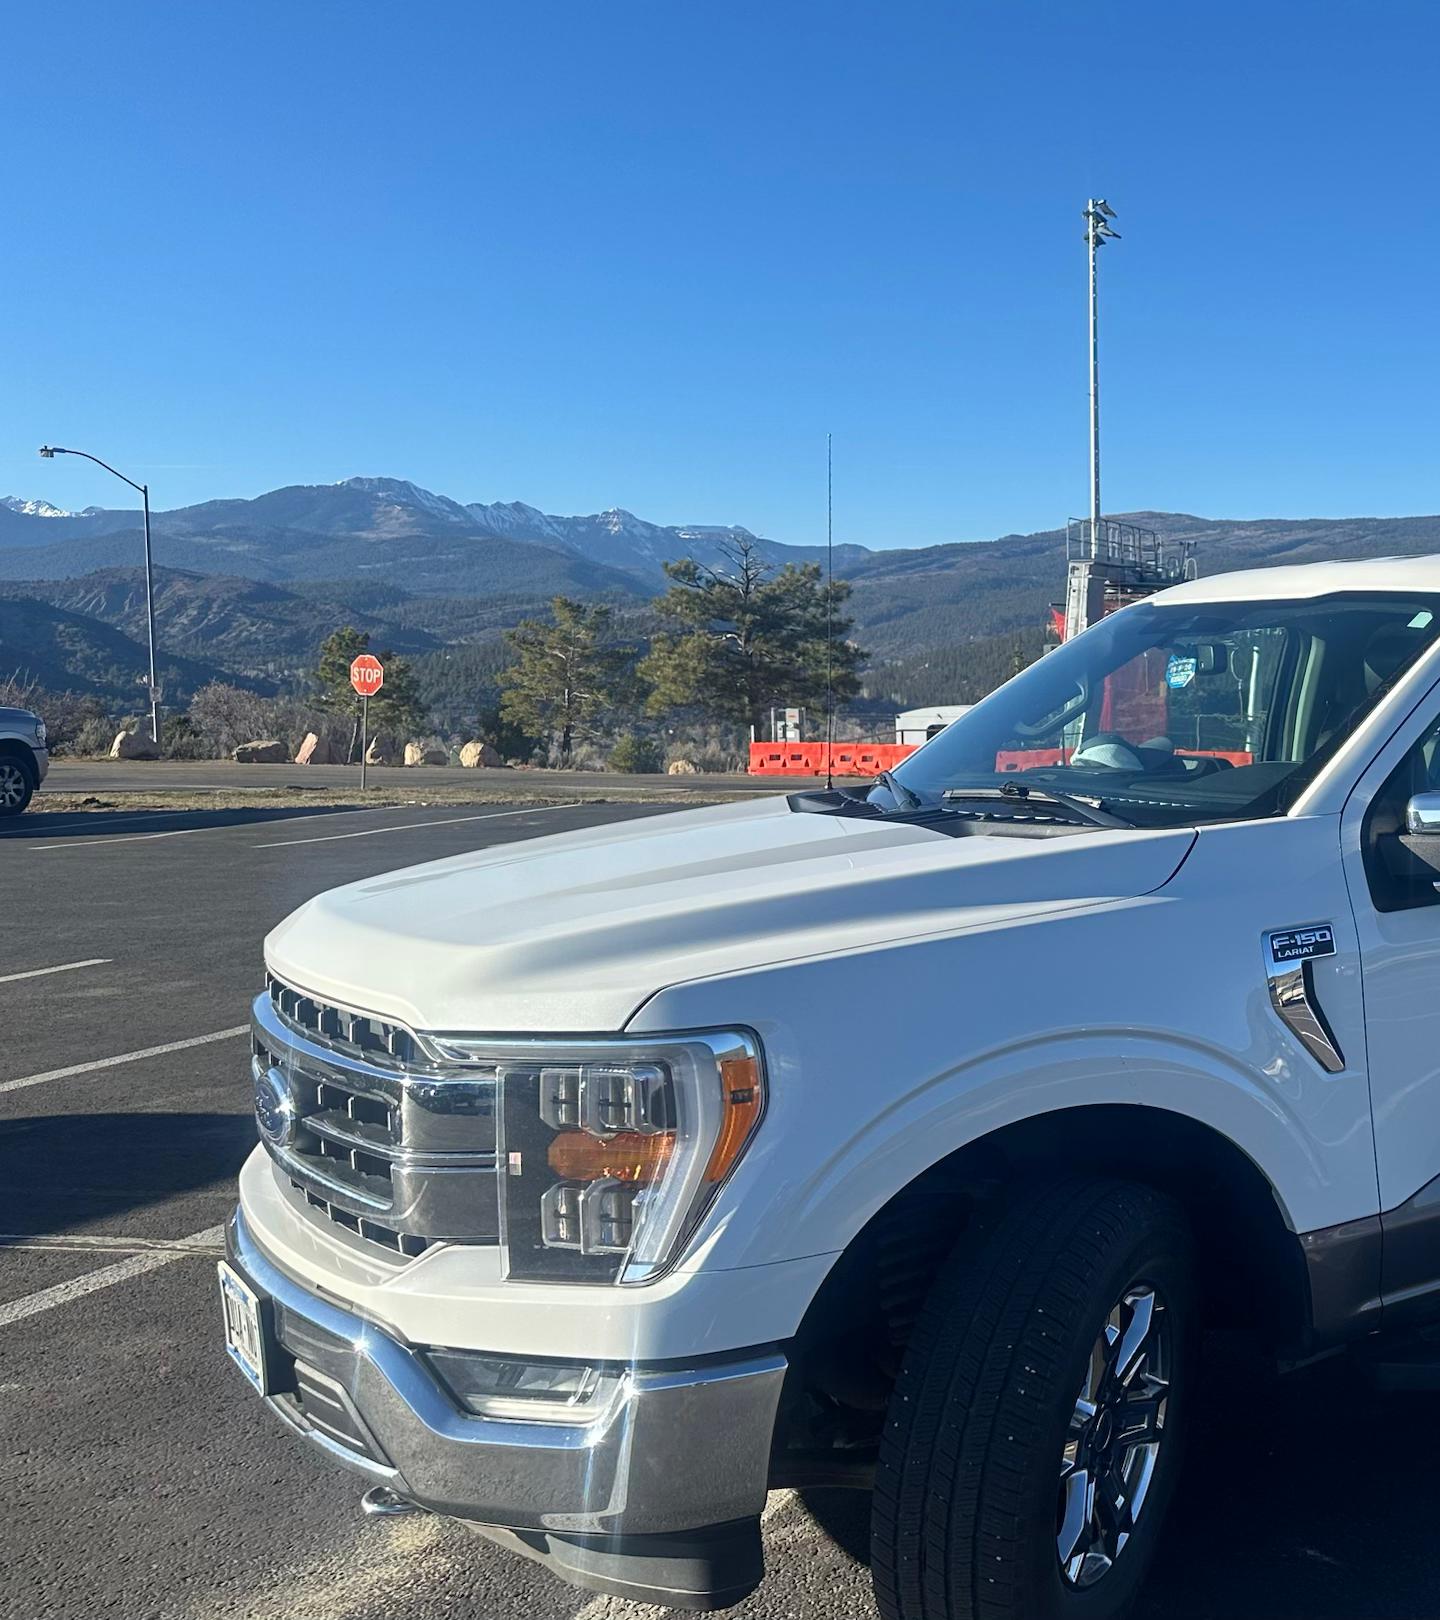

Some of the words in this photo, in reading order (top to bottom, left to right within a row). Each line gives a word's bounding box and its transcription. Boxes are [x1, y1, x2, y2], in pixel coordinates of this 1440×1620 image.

[353, 666, 381, 683] STOP
[1272, 929, 1332, 950] F-150
[1277, 945, 1315, 958] LARIAT
